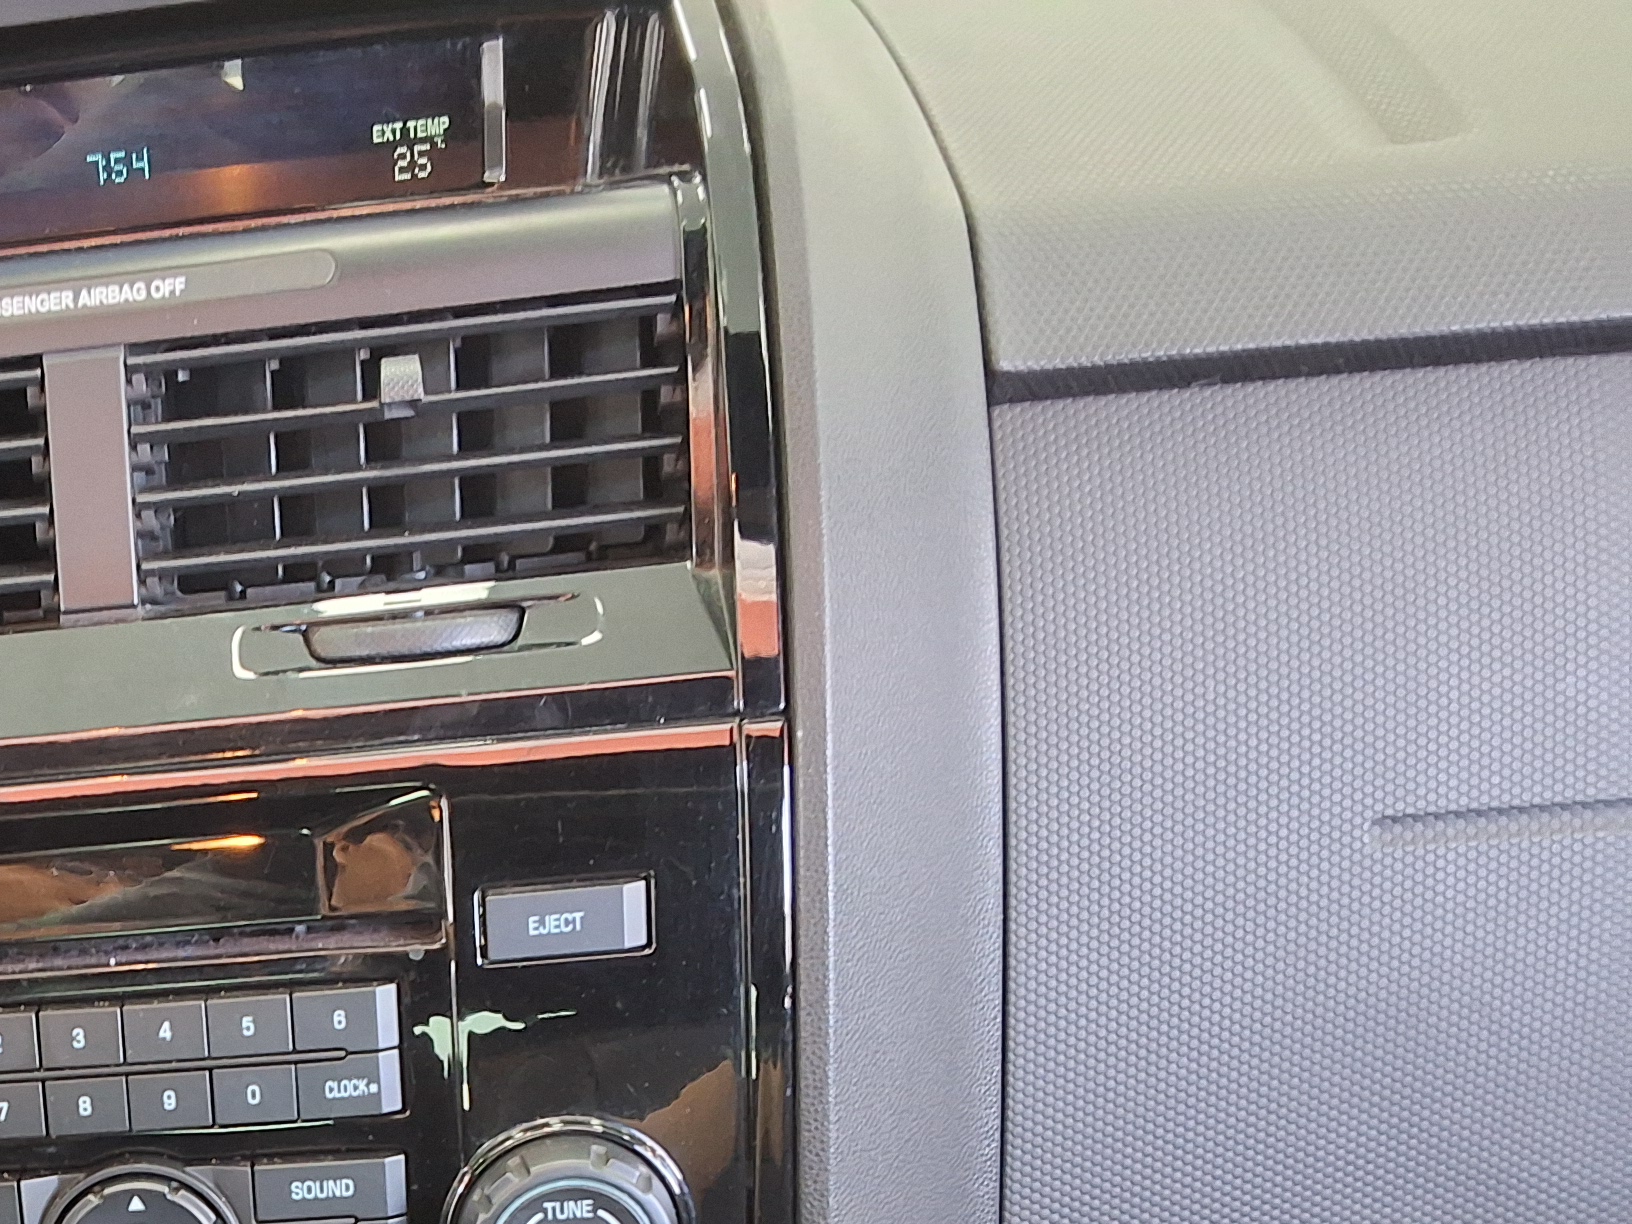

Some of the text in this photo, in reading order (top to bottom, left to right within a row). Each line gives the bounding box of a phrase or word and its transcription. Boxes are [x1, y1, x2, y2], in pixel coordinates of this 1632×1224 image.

[372, 115, 450, 144] EXT TEMP
[86, 146, 150, 186] 7:54
[77, 281, 147, 308] AIRBAG
[150, 276, 187, 299] OFF
[528, 911, 585, 936] EJECT
[158, 1020, 172, 1041] 4
[241, 1015, 255, 1037] 5
[332, 1009, 347, 1030] 6
[71, 1027, 86, 1049] 3
[246, 1084, 261, 1105] 0
[324, 1078, 368, 1099] CLOCK
[78, 1095, 93, 1117] 8
[162, 1089, 177, 1111] 9
[290, 1178, 355, 1200] SOUND
[542, 1199, 594, 1220] TUNE
